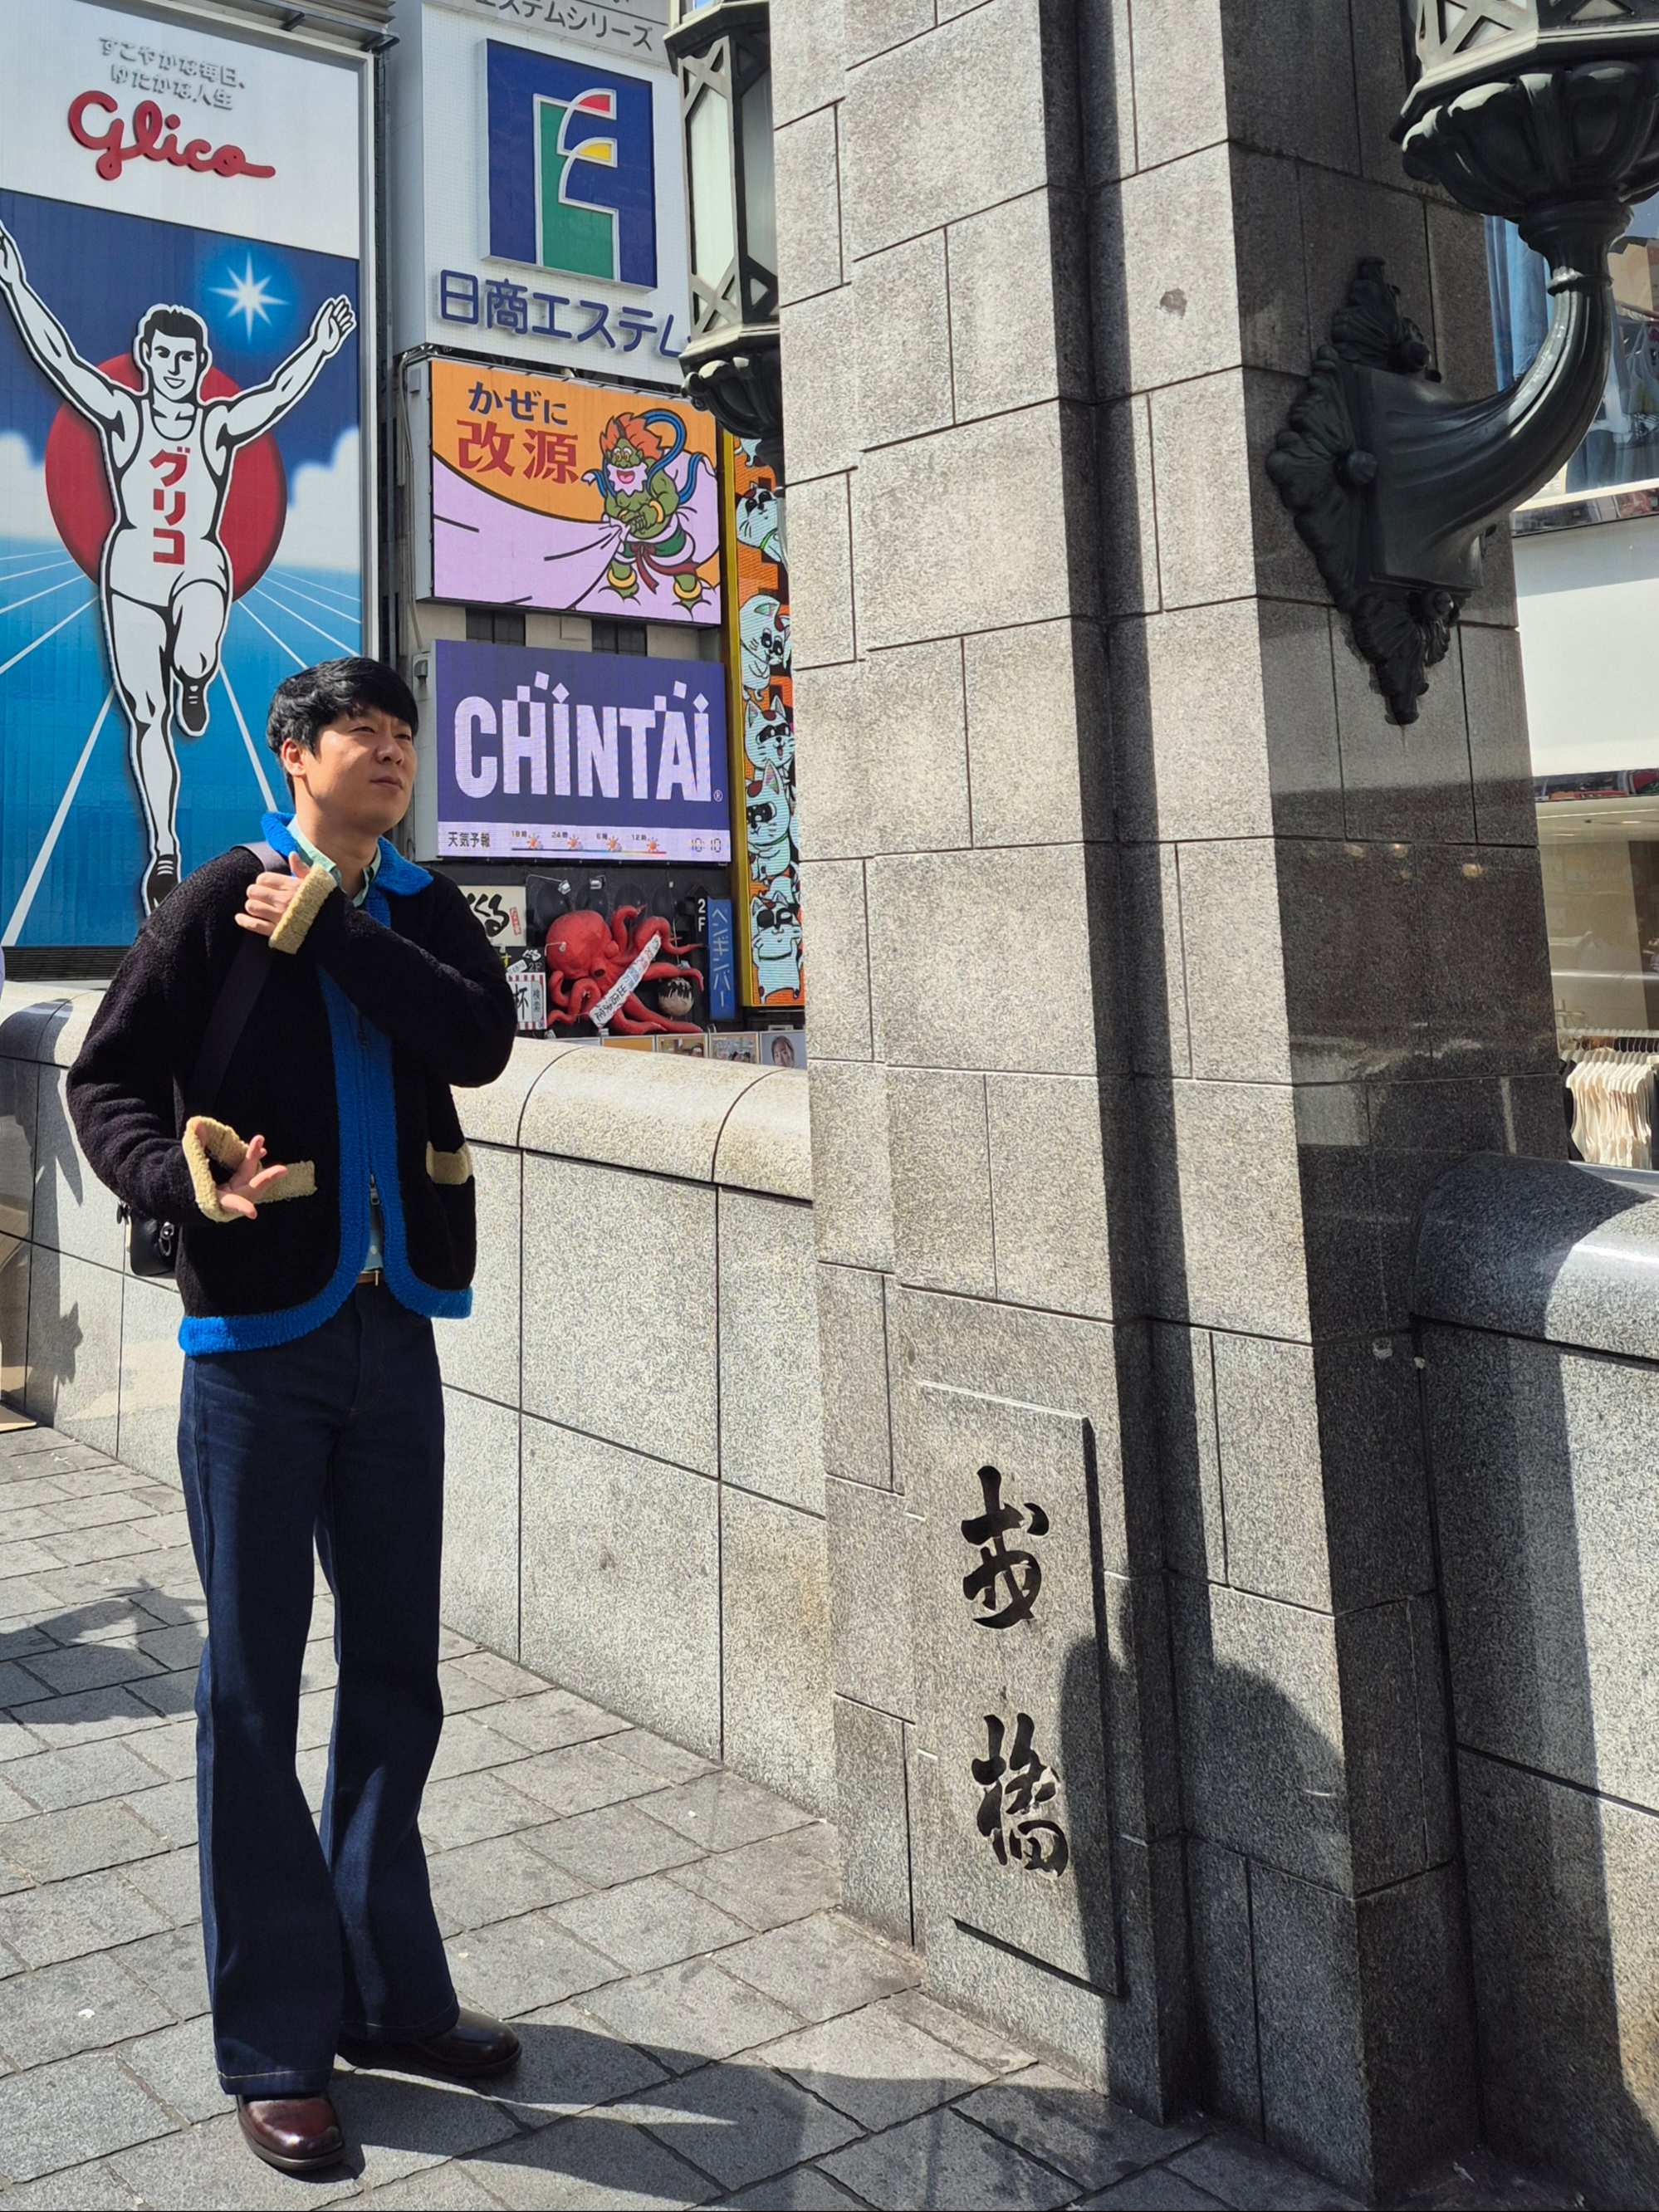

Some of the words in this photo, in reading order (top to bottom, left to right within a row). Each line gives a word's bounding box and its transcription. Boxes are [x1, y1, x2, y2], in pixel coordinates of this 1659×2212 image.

[474, 0, 653, 51] ステムシリーズ
[68, 90, 276, 181] Glico
[467, 381, 569, 427] かぜに
[457, 418, 580, 484] 改源
[149, 446, 192, 566] グリコ
[448, 831, 491, 848] 天気予報
